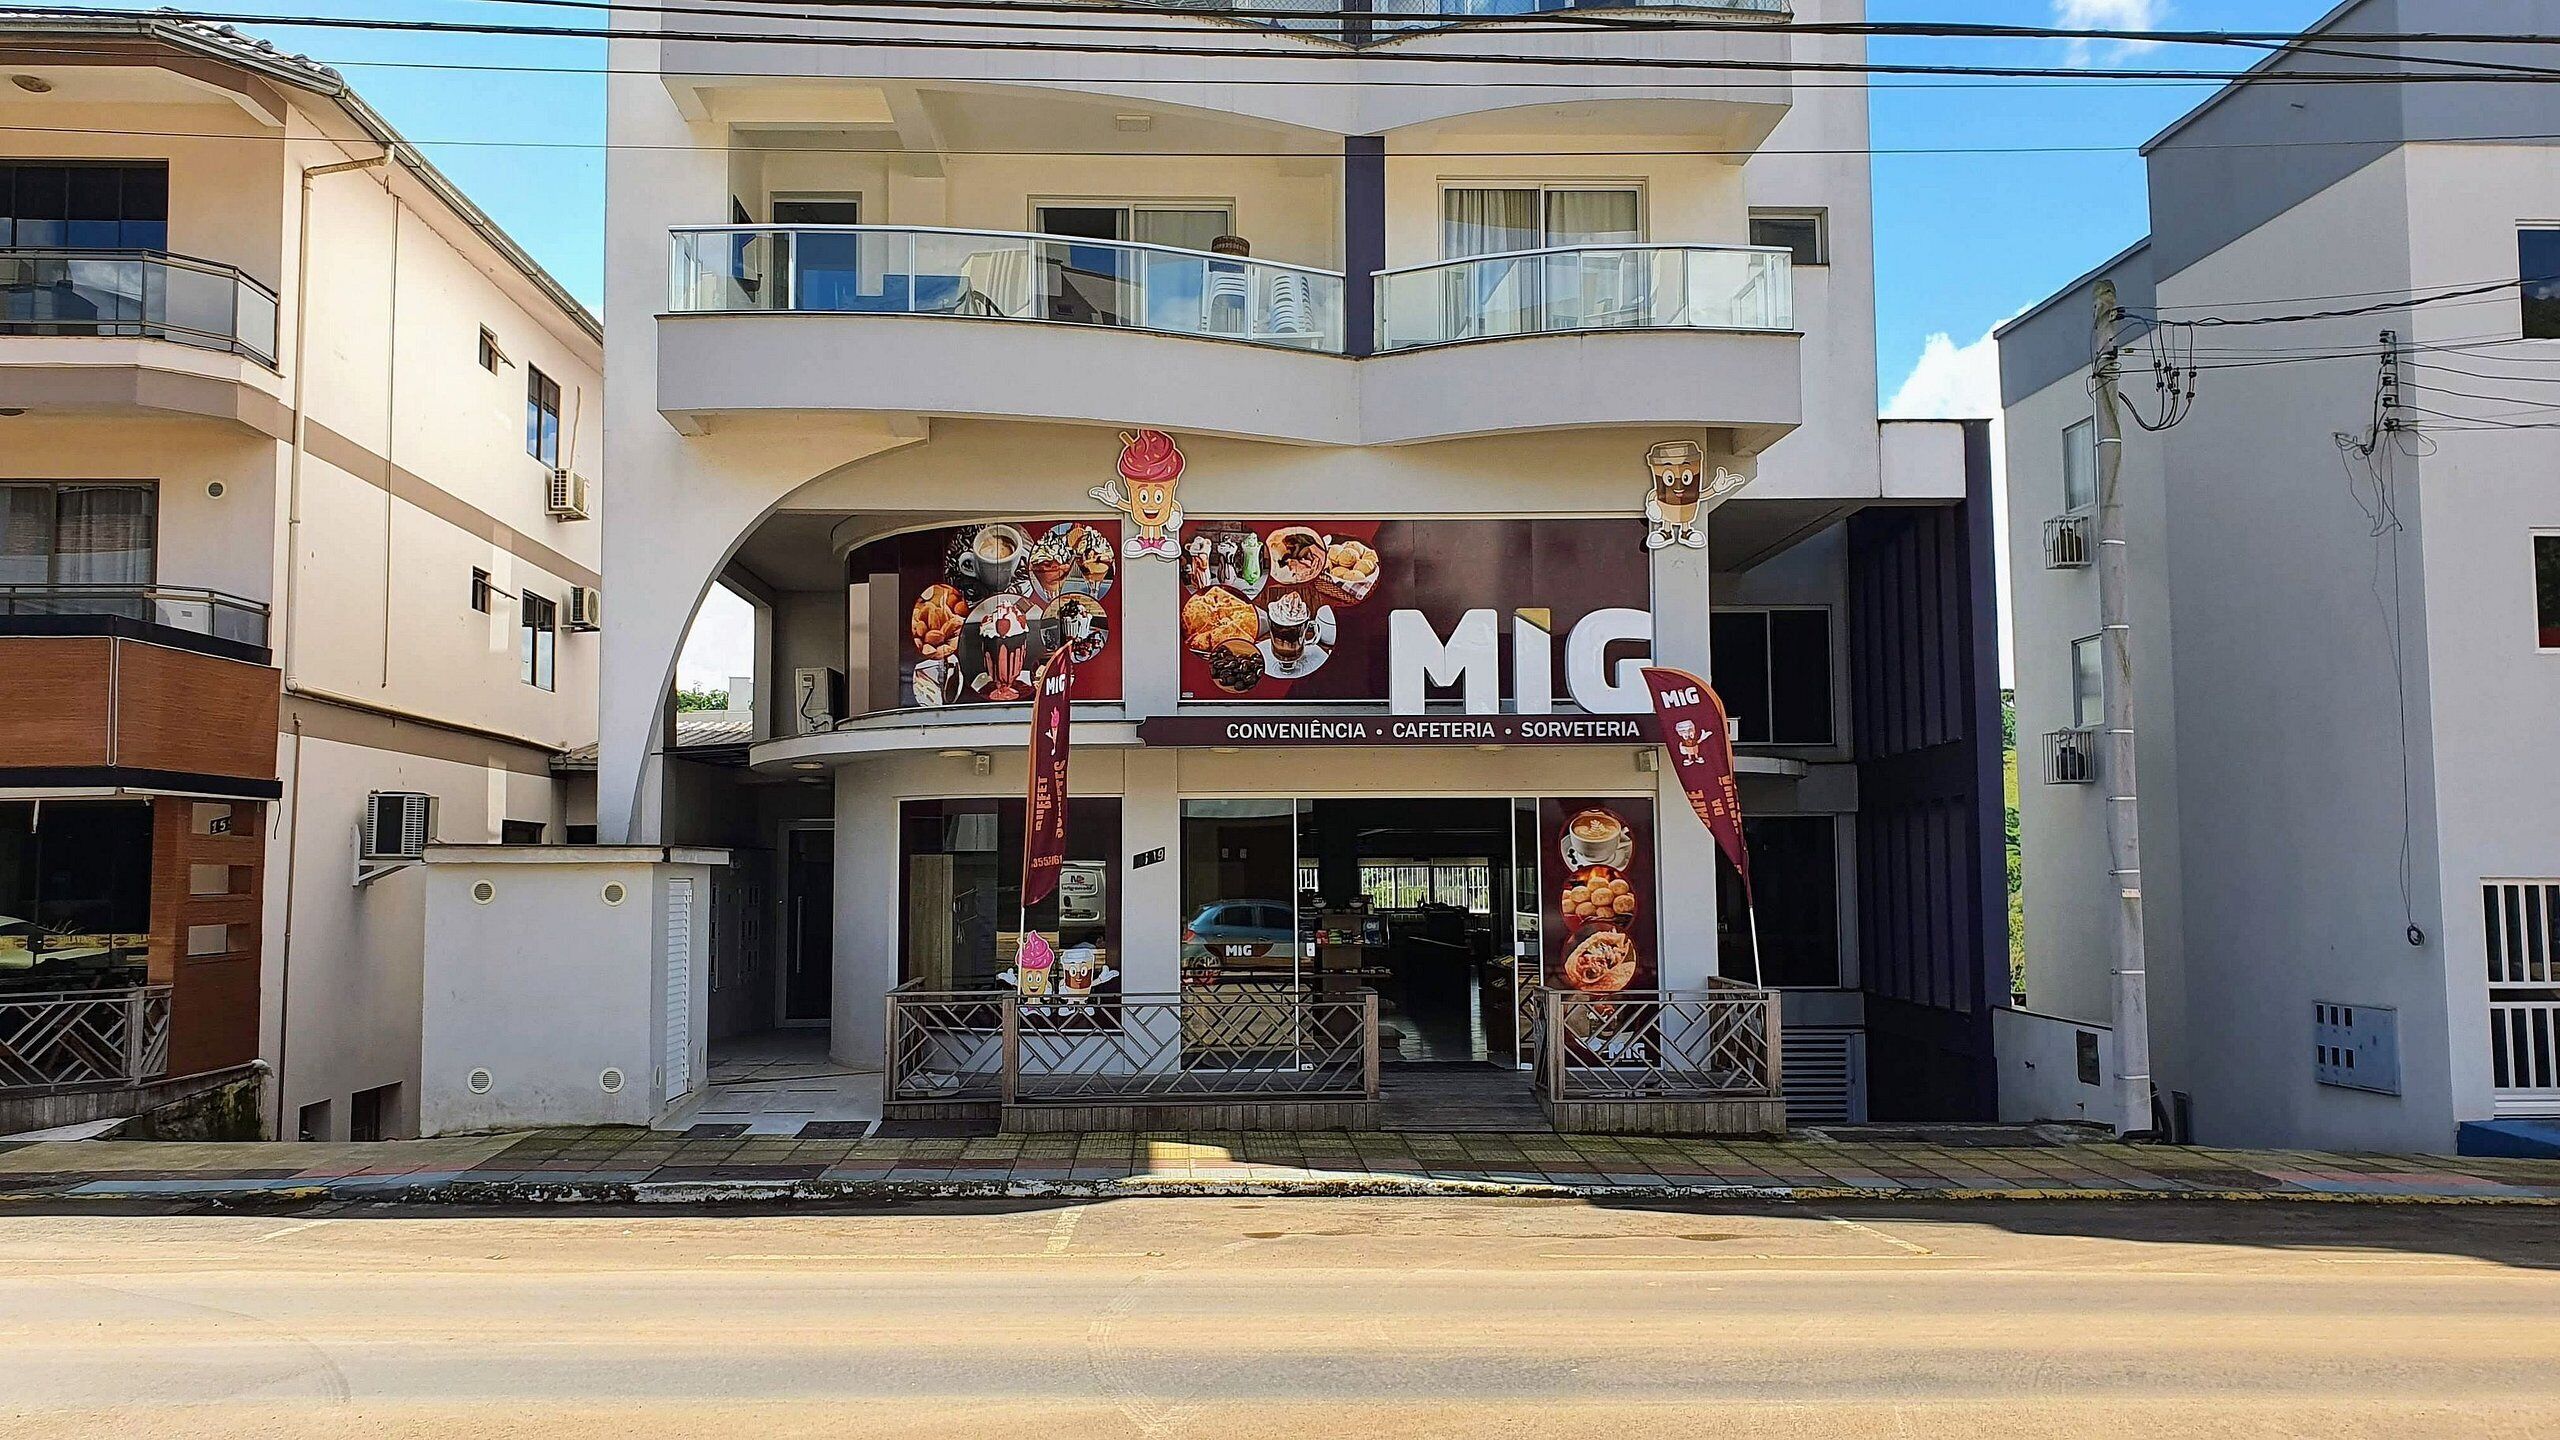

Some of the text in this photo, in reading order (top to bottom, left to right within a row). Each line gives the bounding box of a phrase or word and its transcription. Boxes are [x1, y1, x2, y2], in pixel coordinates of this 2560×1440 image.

[1226, 719, 1641, 740] CONVENIÊNCIA CAFETERIA SORVETERIA
[1710, 798, 1725, 817] DA
[1225, 944, 1253, 957] MIG
